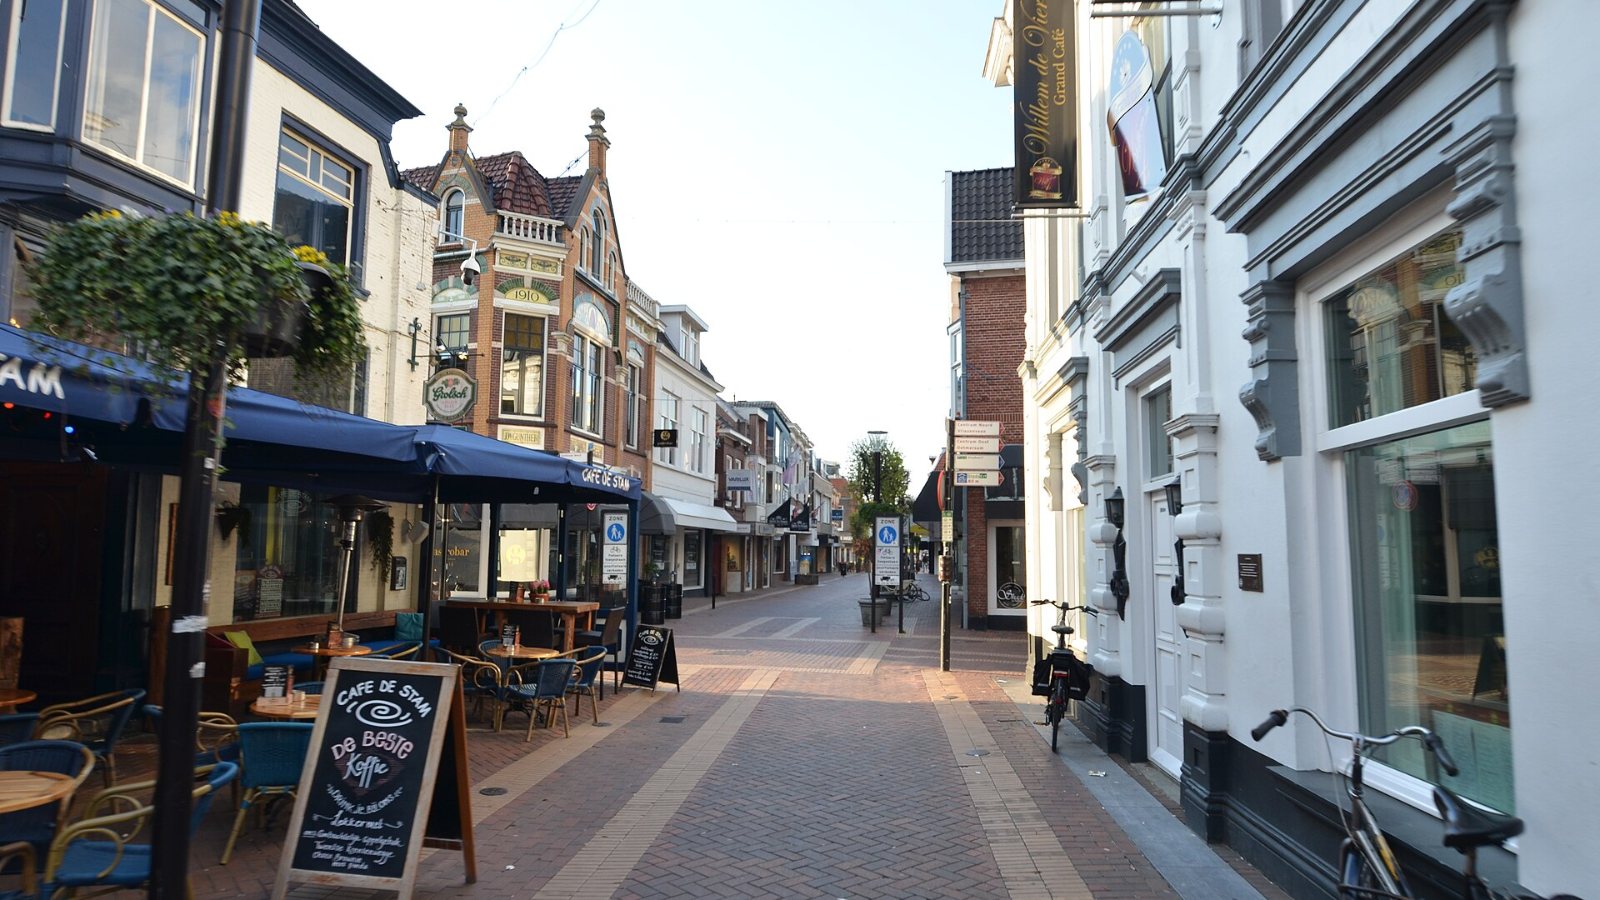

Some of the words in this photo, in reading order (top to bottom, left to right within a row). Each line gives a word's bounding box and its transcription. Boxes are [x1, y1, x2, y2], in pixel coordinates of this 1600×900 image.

[1051, 28, 1065, 59] Café
[1028, 52, 1049, 76] de
[1053, 62, 1066, 106] Grand
[1020, 82, 1050, 155] Willem
[515, 289, 540, 302] 1910
[432, 386, 468, 402] Grolsch
[582, 468, 601, 485] CAFE
[602, 471, 612, 487] DE
[613, 474, 630, 492] STAM
[336, 680, 375, 706] CAFE
[378, 679, 398, 694] DE
[398, 684, 433, 718] STAM
[342, 752, 390, 789] Koffie
